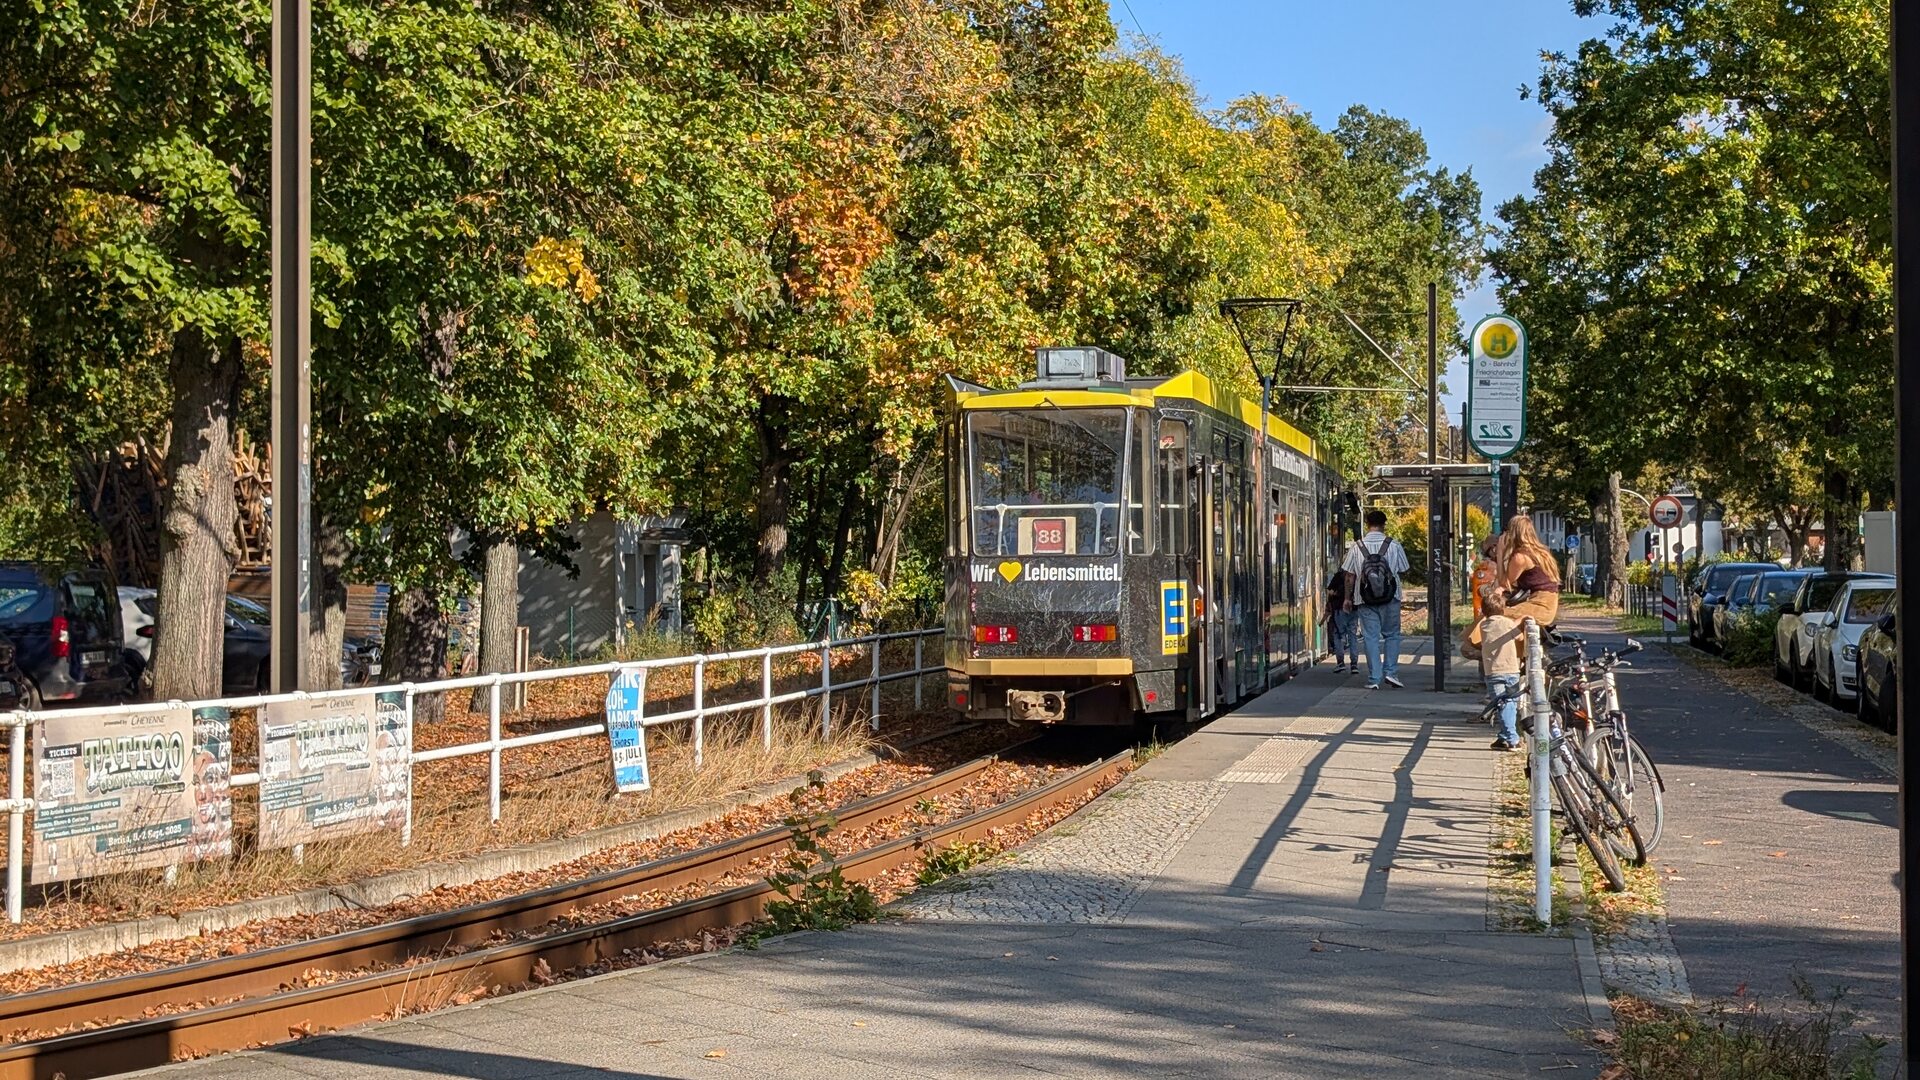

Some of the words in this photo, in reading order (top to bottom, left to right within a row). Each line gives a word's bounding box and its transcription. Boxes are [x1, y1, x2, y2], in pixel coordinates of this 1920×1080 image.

[1491, 334, 1507, 351] H
[1038, 529, 1061, 544] 88
[970, 564, 996, 583] Wir
[1024, 563, 1122, 582] Lebensmittel.
[1165, 638, 1186, 649] EDEKA
[131, 714, 167, 726] CHEYENNE
[48, 747, 78, 758] TICKETS
[625, 747, 643, 762] JULI
[83, 731, 184, 791] TATTOO
[165, 824, 183, 835] 2025
